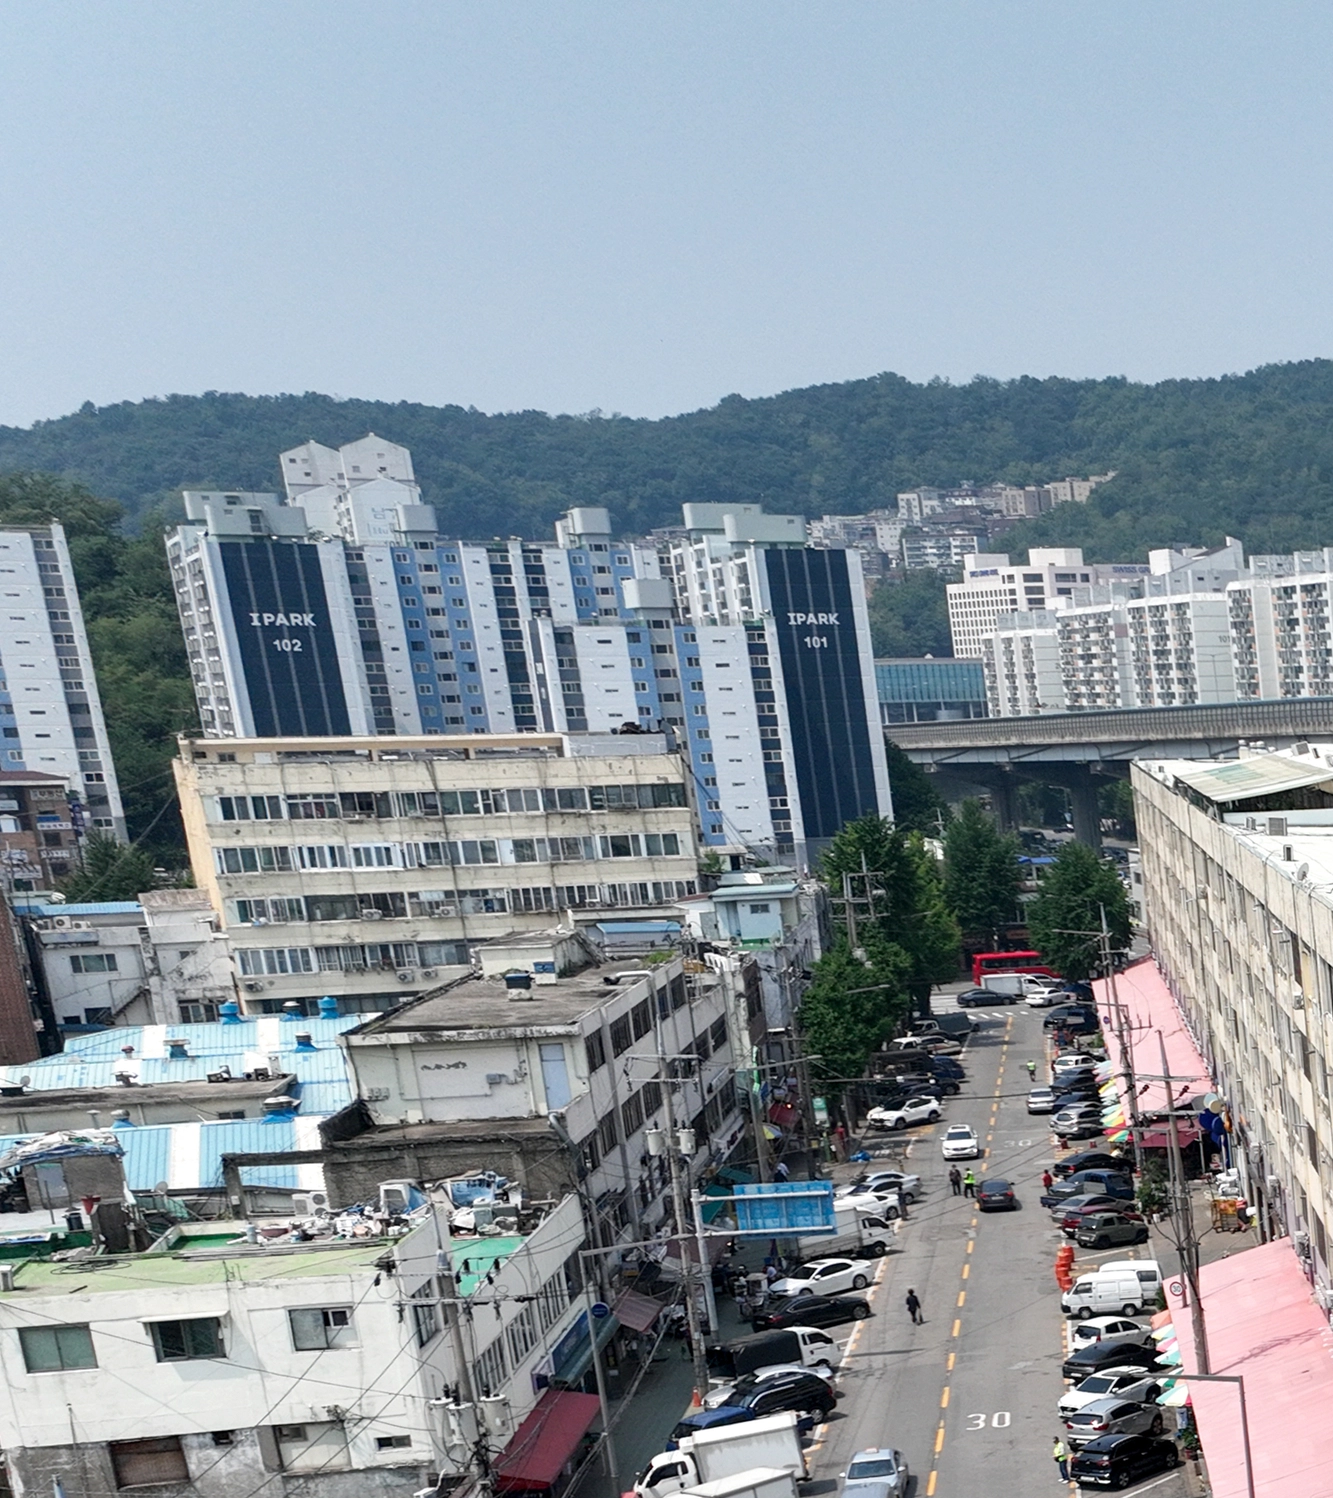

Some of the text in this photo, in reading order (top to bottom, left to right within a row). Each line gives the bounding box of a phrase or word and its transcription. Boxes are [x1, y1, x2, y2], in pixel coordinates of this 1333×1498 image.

[249, 612, 317, 627] IPARK
[787, 612, 841, 625] IPARK
[273, 639, 303, 652] 102
[804, 636, 828, 649] 101
[1171, 1284, 1182, 1293] 30
[966, 1411, 1012, 1431] 30
